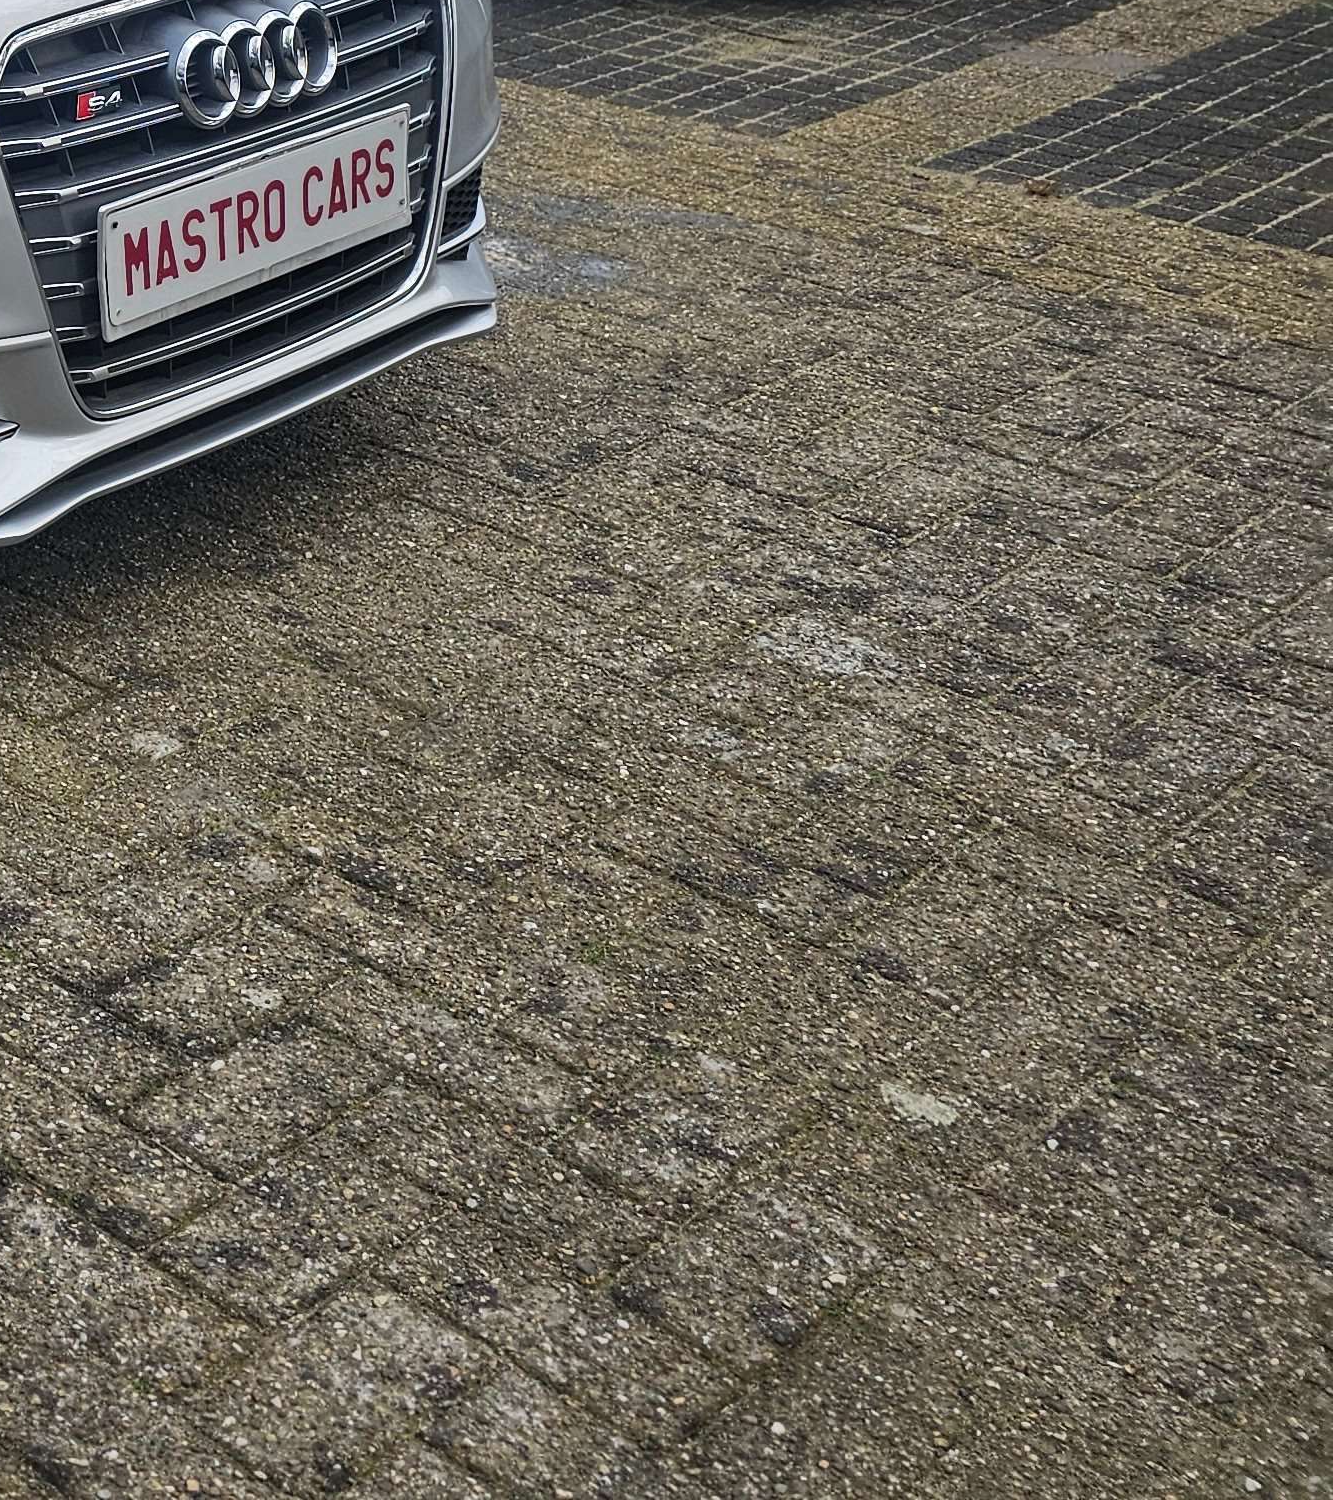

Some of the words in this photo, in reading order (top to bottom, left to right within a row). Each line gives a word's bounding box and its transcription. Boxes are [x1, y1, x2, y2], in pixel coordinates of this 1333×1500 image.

[85, 90, 123, 112] S4
[123, 179, 286, 296] MASTRO
[302, 138, 395, 227] CARS
